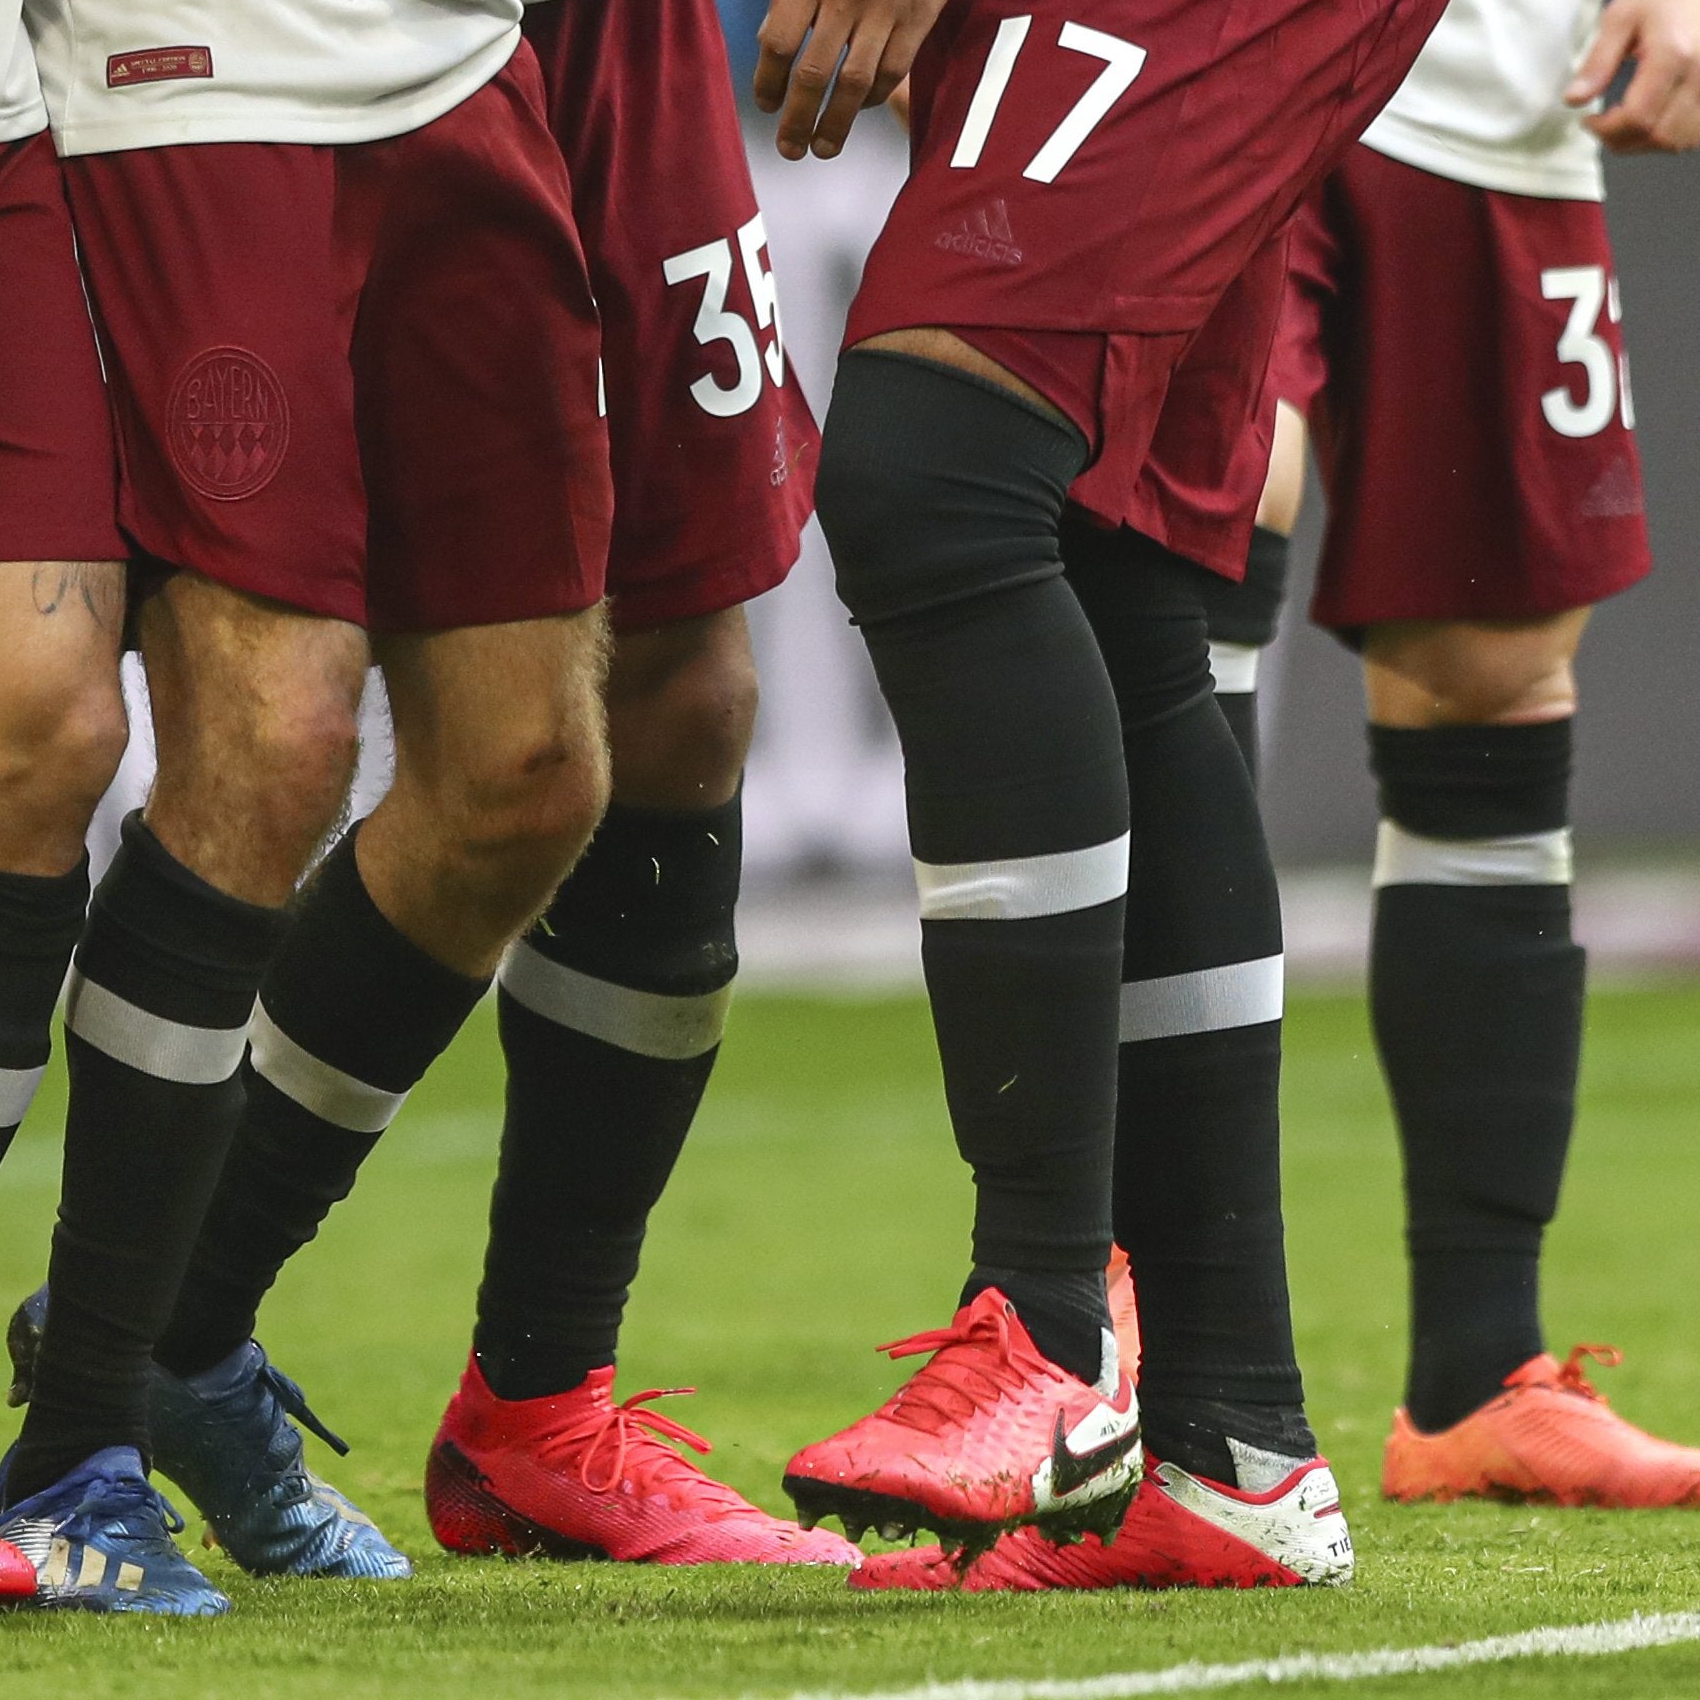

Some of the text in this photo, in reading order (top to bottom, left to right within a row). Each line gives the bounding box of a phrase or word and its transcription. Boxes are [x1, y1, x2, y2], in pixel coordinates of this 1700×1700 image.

[950, 14, 1147, 184] 17
[187, 364, 269, 420] BAYERN
[663, 211, 783, 417] 35
[1541, 267, 1635, 438] 3
